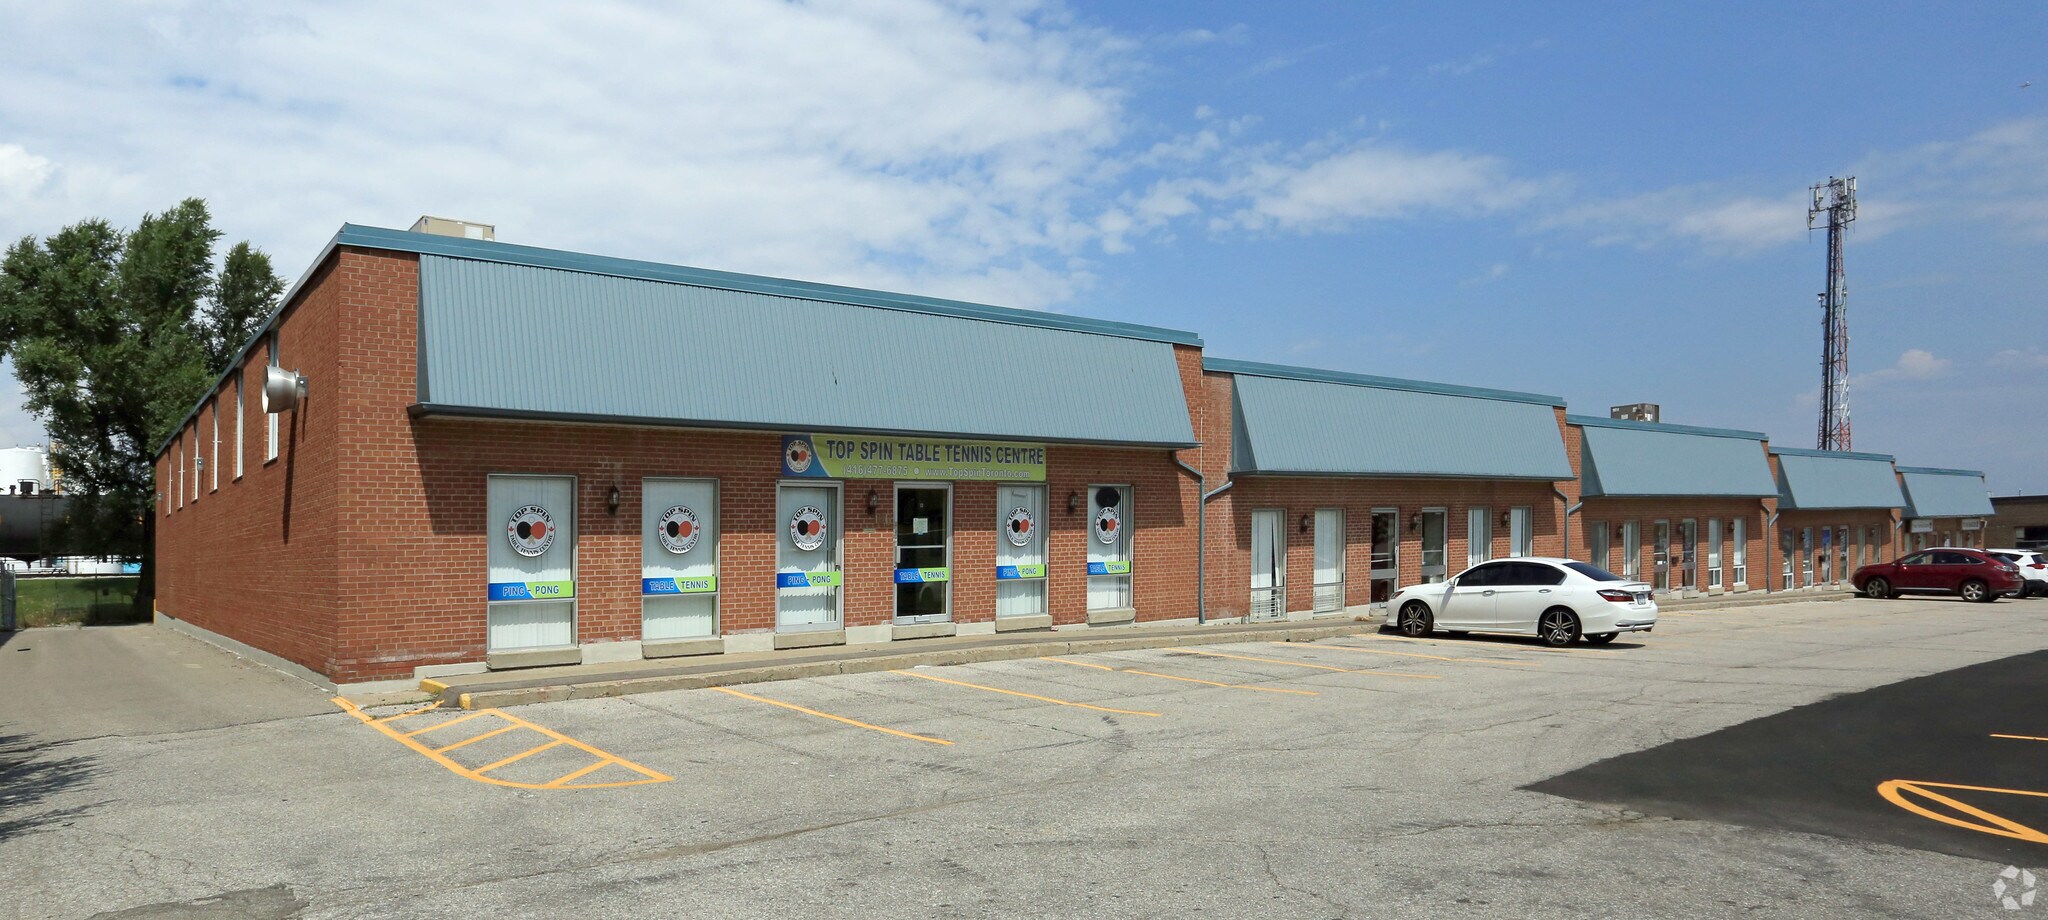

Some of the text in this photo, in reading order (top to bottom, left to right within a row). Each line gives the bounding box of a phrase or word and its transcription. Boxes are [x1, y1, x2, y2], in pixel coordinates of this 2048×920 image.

[826, 440, 1044, 464] TOP SPIN TABLE TENNIS CENTRE
[843, 464, 1031, 479] (416)477-6875 www.TopSpinToronto.com
[510, 506, 552, 523] TOP SPIN
[662, 506, 697, 523] TOP SPIN
[793, 506, 824, 521] TOP SPIN
[1009, 507, 1033, 520] TOP SPIN
[1002, 567, 1017, 577] PING
[1022, 567, 1037, 575] PONG
[1108, 563, 1126, 571] TENNIS
[787, 575, 805, 586] PING
[812, 575, 831, 584] PONG
[899, 570, 945, 580] TABLE TENNIS
[502, 585, 525, 597] PING
[535, 584, 560, 595] PONG
[649, 579, 709, 591] TABLE TENNIS
